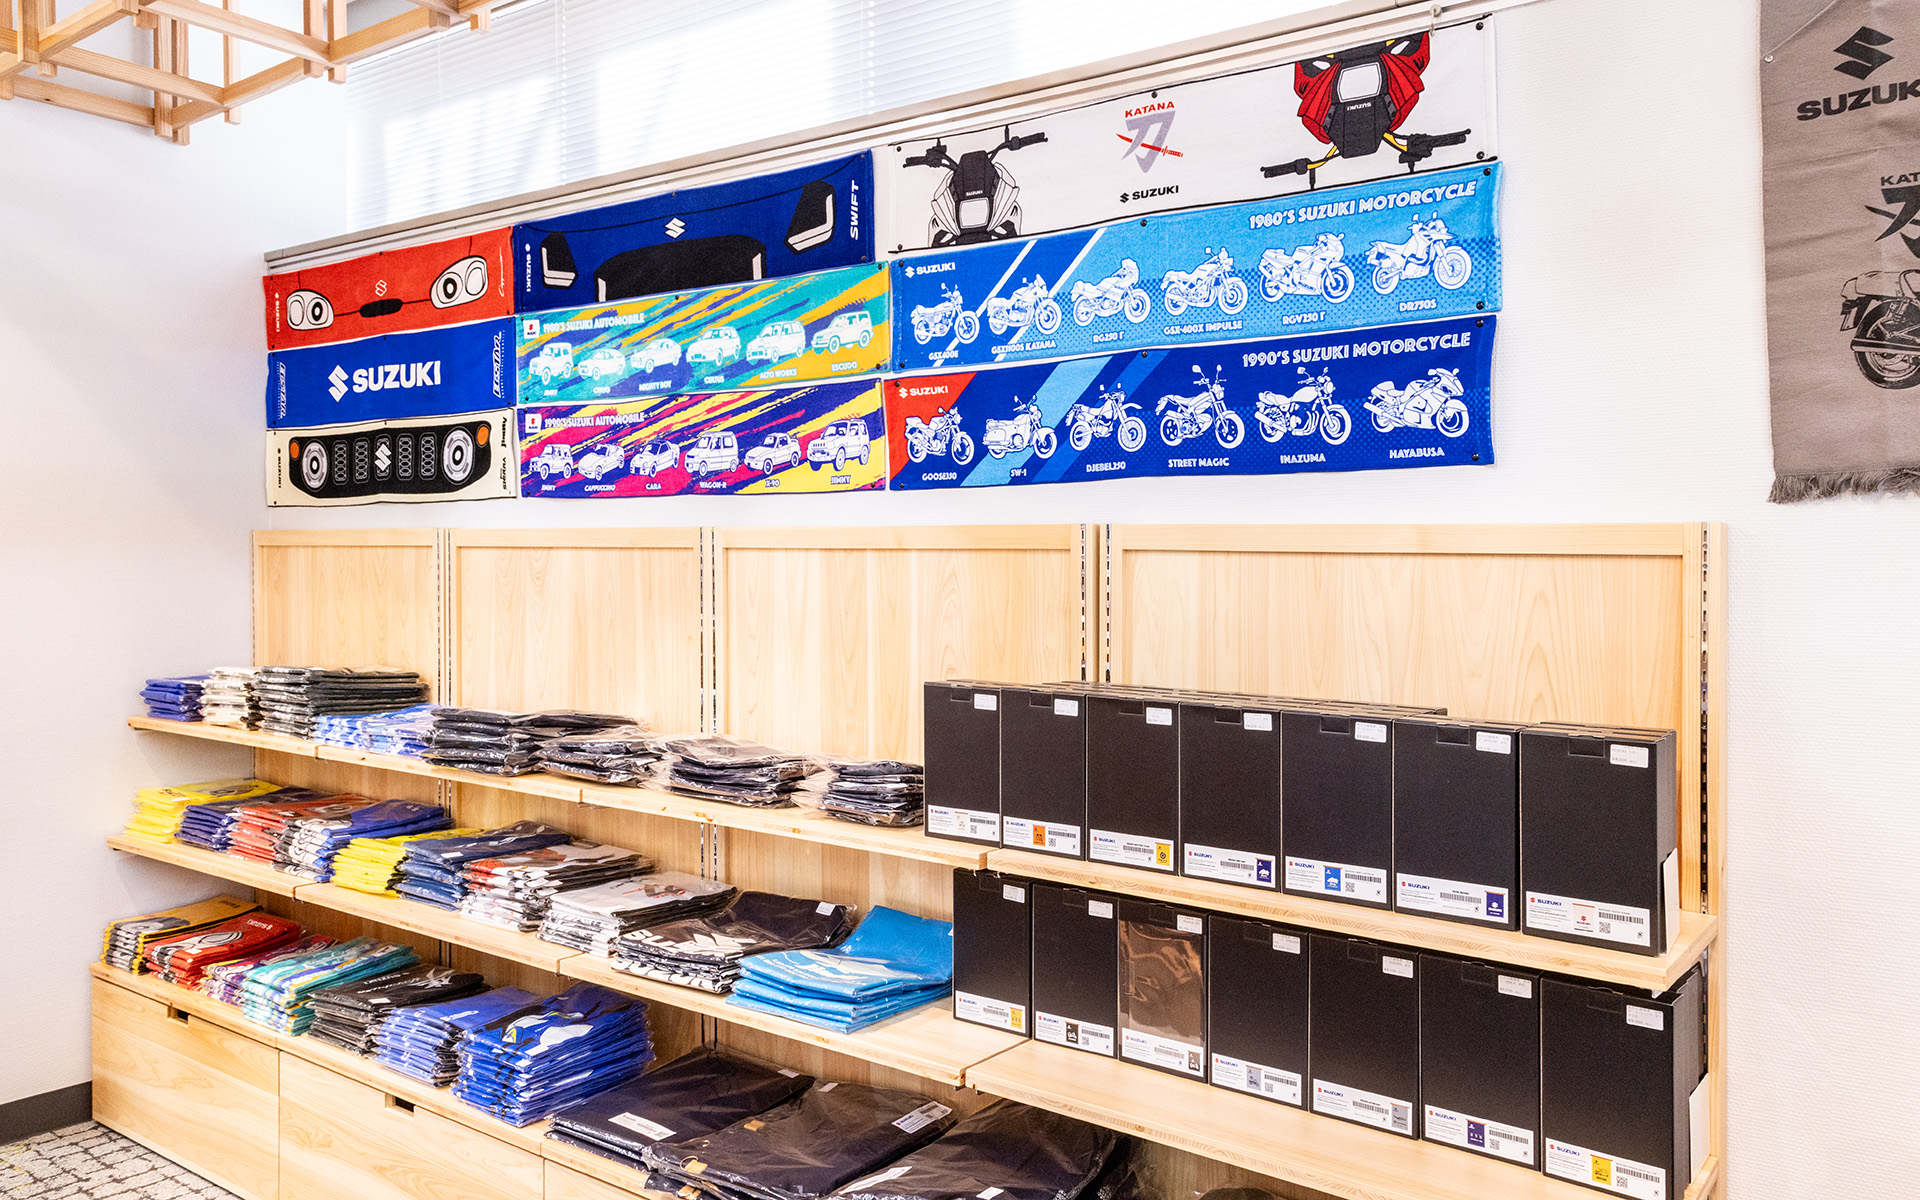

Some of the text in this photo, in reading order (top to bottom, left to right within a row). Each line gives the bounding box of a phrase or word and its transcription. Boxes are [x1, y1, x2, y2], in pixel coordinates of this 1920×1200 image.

[1796, 78, 1920, 121] SUZUK
[1124, 101, 1175, 118] KATANA
[965, 189, 983, 197] SUZUKI
[1132, 185, 1179, 201] SUZUKI
[850, 180, 860, 240] SWIFT
[1249, 181, 1477, 229] 1980'S SUZUKI MOTORCYCLE
[916, 262, 956, 275] SUZUKI
[1399, 299, 1437, 312] DR750S
[543, 313, 645, 333] 1980'S SUZUKI AUTOMOBILE
[1282, 312, 1318, 325] RGV250
[1205, 320, 1243, 332] IMPULSE
[1025, 340, 1056, 351] KATANA
[1242, 332, 1471, 368] 1990'S SUZUKI MOTORCYCLE
[831, 361, 858, 372] ESCUDO
[352, 360, 441, 393] SUZUKI
[759, 368, 797, 380] ALTO WORKS
[909, 385, 949, 397] SUZUKI
[544, 412, 645, 428] 1990'S SUZUKI AUTOMOBILE
[1280, 453, 1326, 464] INAZUMA
[1389, 447, 1445, 459] HAYABUSA
[1086, 461, 1126, 473] DJEBEL250
[1168, 457, 1230, 468] STREET MAGIC
[645, 482, 662, 490] CARA
[700, 481, 727, 489] WAGON-R
[1407, 882, 1430, 890] SUZUKI
[1537, 898, 1562, 907] SUZUKI
[1323, 1089, 1344, 1098] SUZUKI
[1434, 1111, 1457, 1121] SUZUKI
[1556, 1145, 1580, 1156] SUZUKI
